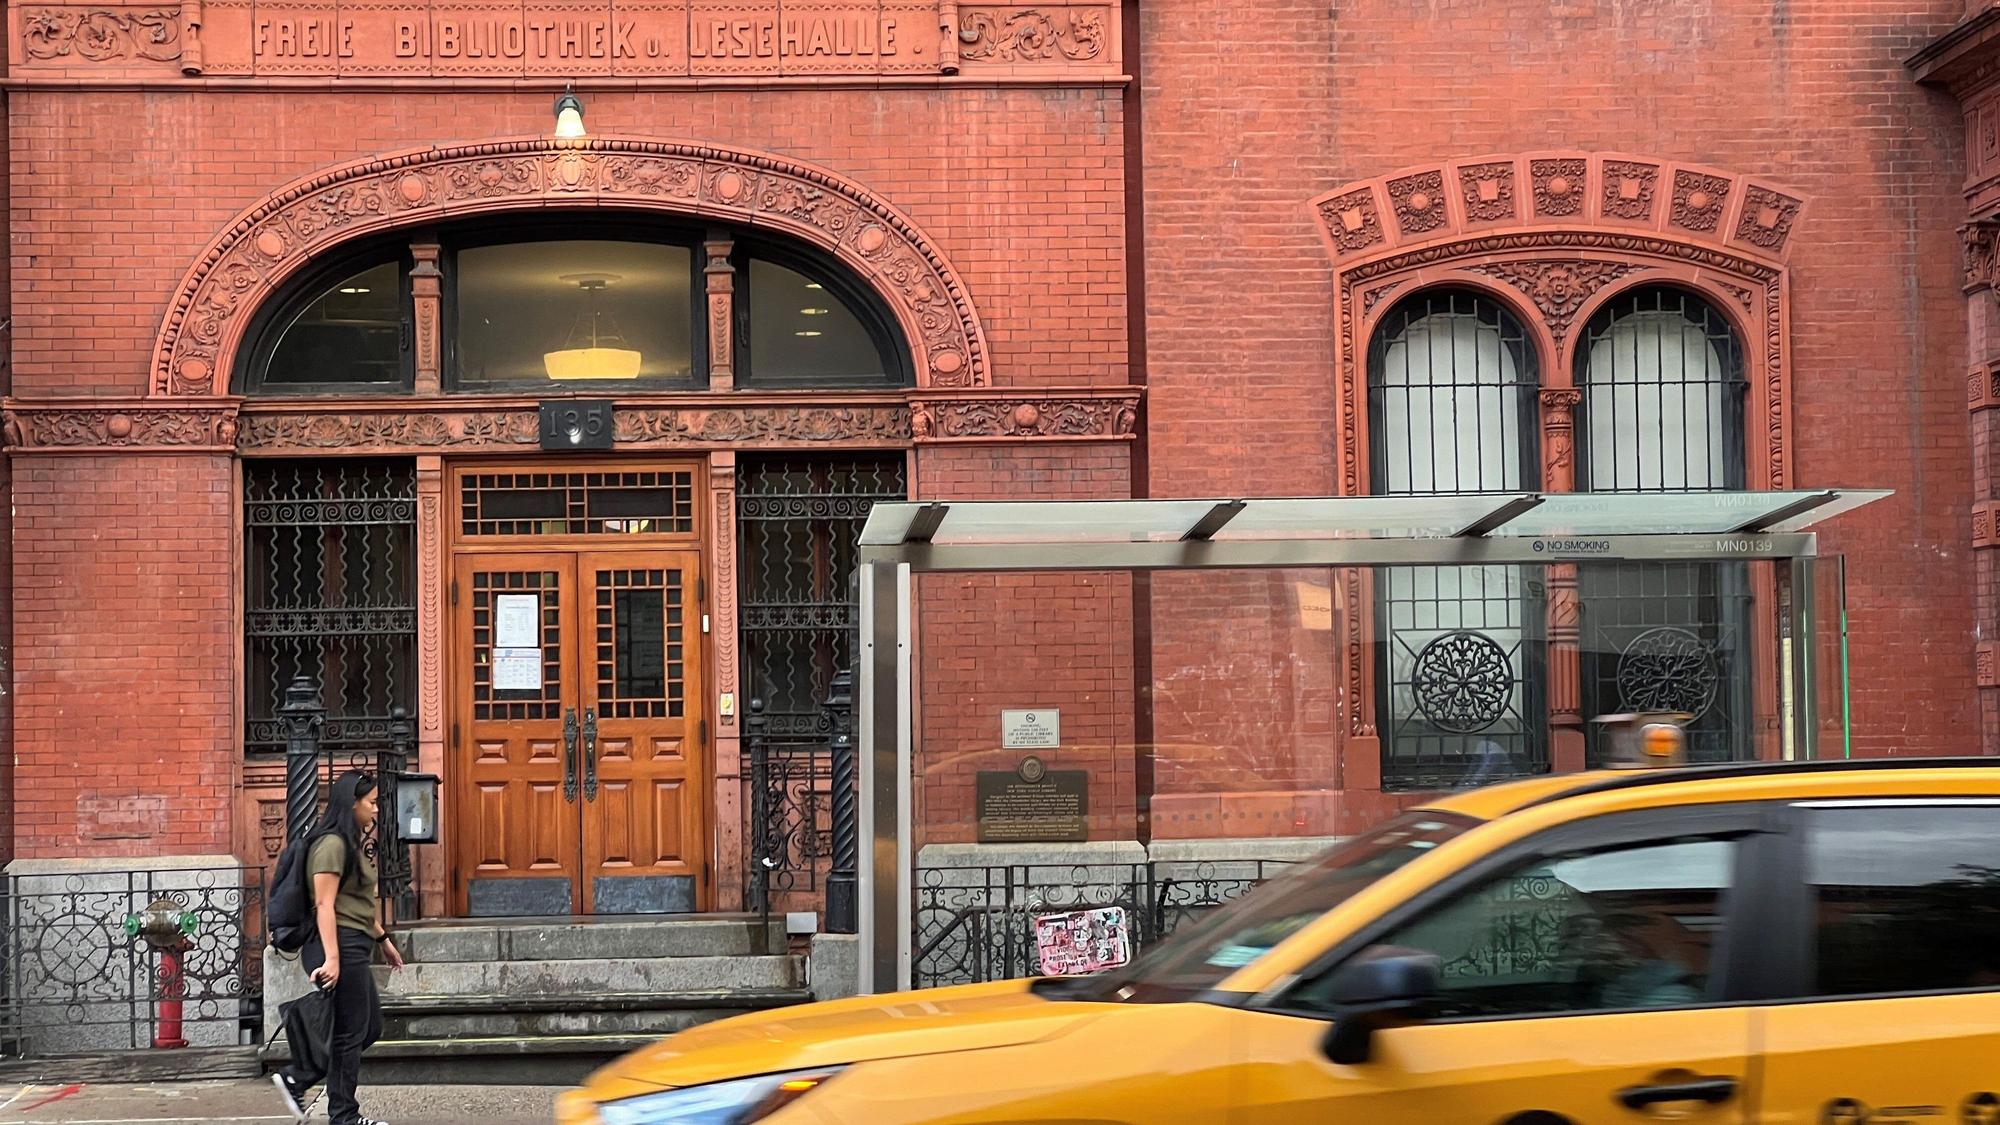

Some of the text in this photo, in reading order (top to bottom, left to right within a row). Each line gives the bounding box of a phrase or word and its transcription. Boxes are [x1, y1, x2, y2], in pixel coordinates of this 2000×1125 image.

[254, 19, 354, 58] FREIE
[394, 20, 636, 58] BIBLIOTHEK
[549, 409, 603, 438] 135
[1547, 540, 1610, 550] NO SMOKING
[1716, 540, 1773, 552] MN0139
